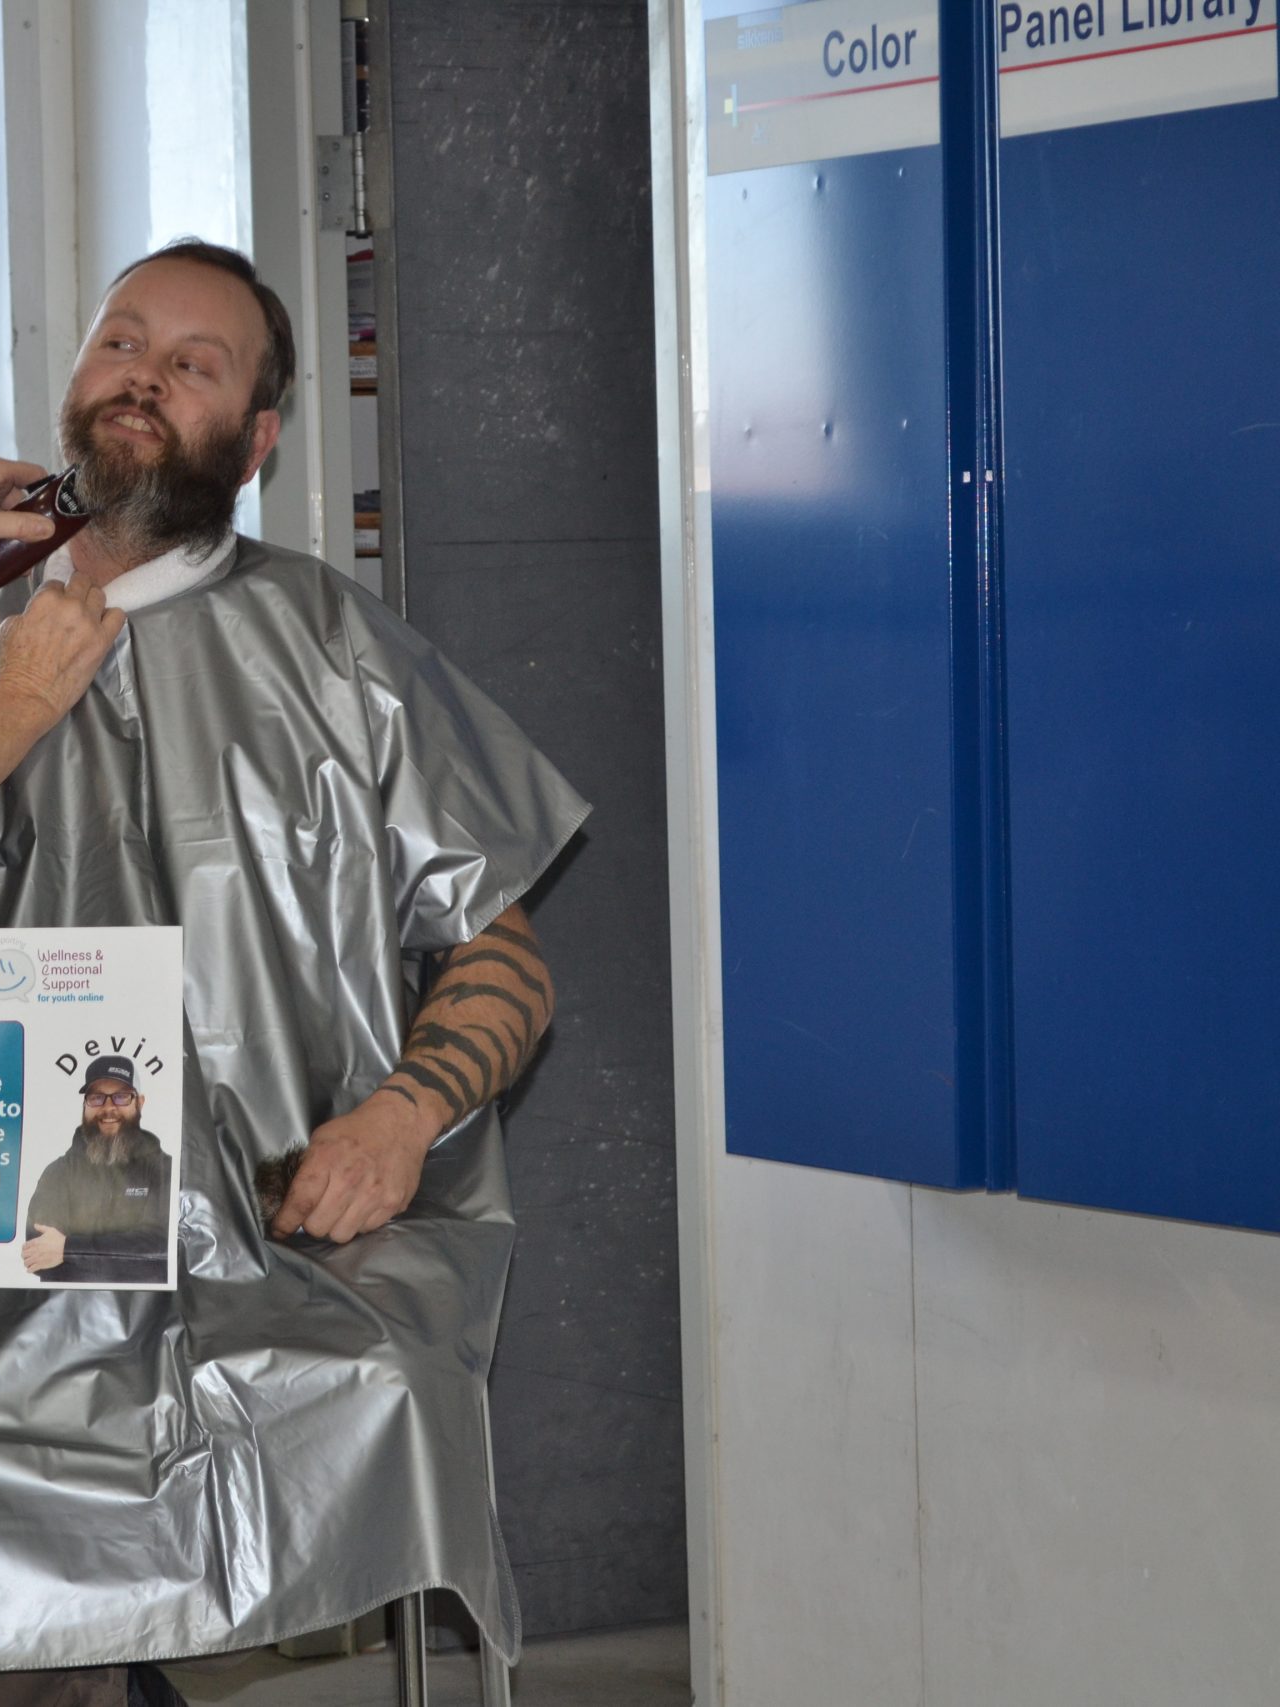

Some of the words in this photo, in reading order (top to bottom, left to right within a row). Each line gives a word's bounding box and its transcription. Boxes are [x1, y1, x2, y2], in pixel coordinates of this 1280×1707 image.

[1001, 0, 1104, 53] Panel
[823, 23, 917, 77] Color
[37, 949, 92, 961] Wellness
[95, 949, 103, 960] &
[42, 977, 90, 991] Support
[37, 993, 50, 1002] for
[51, 993, 76, 1003] youth
[78, 993, 104, 1002] online
[55, 1036, 163, 1076] Devin
